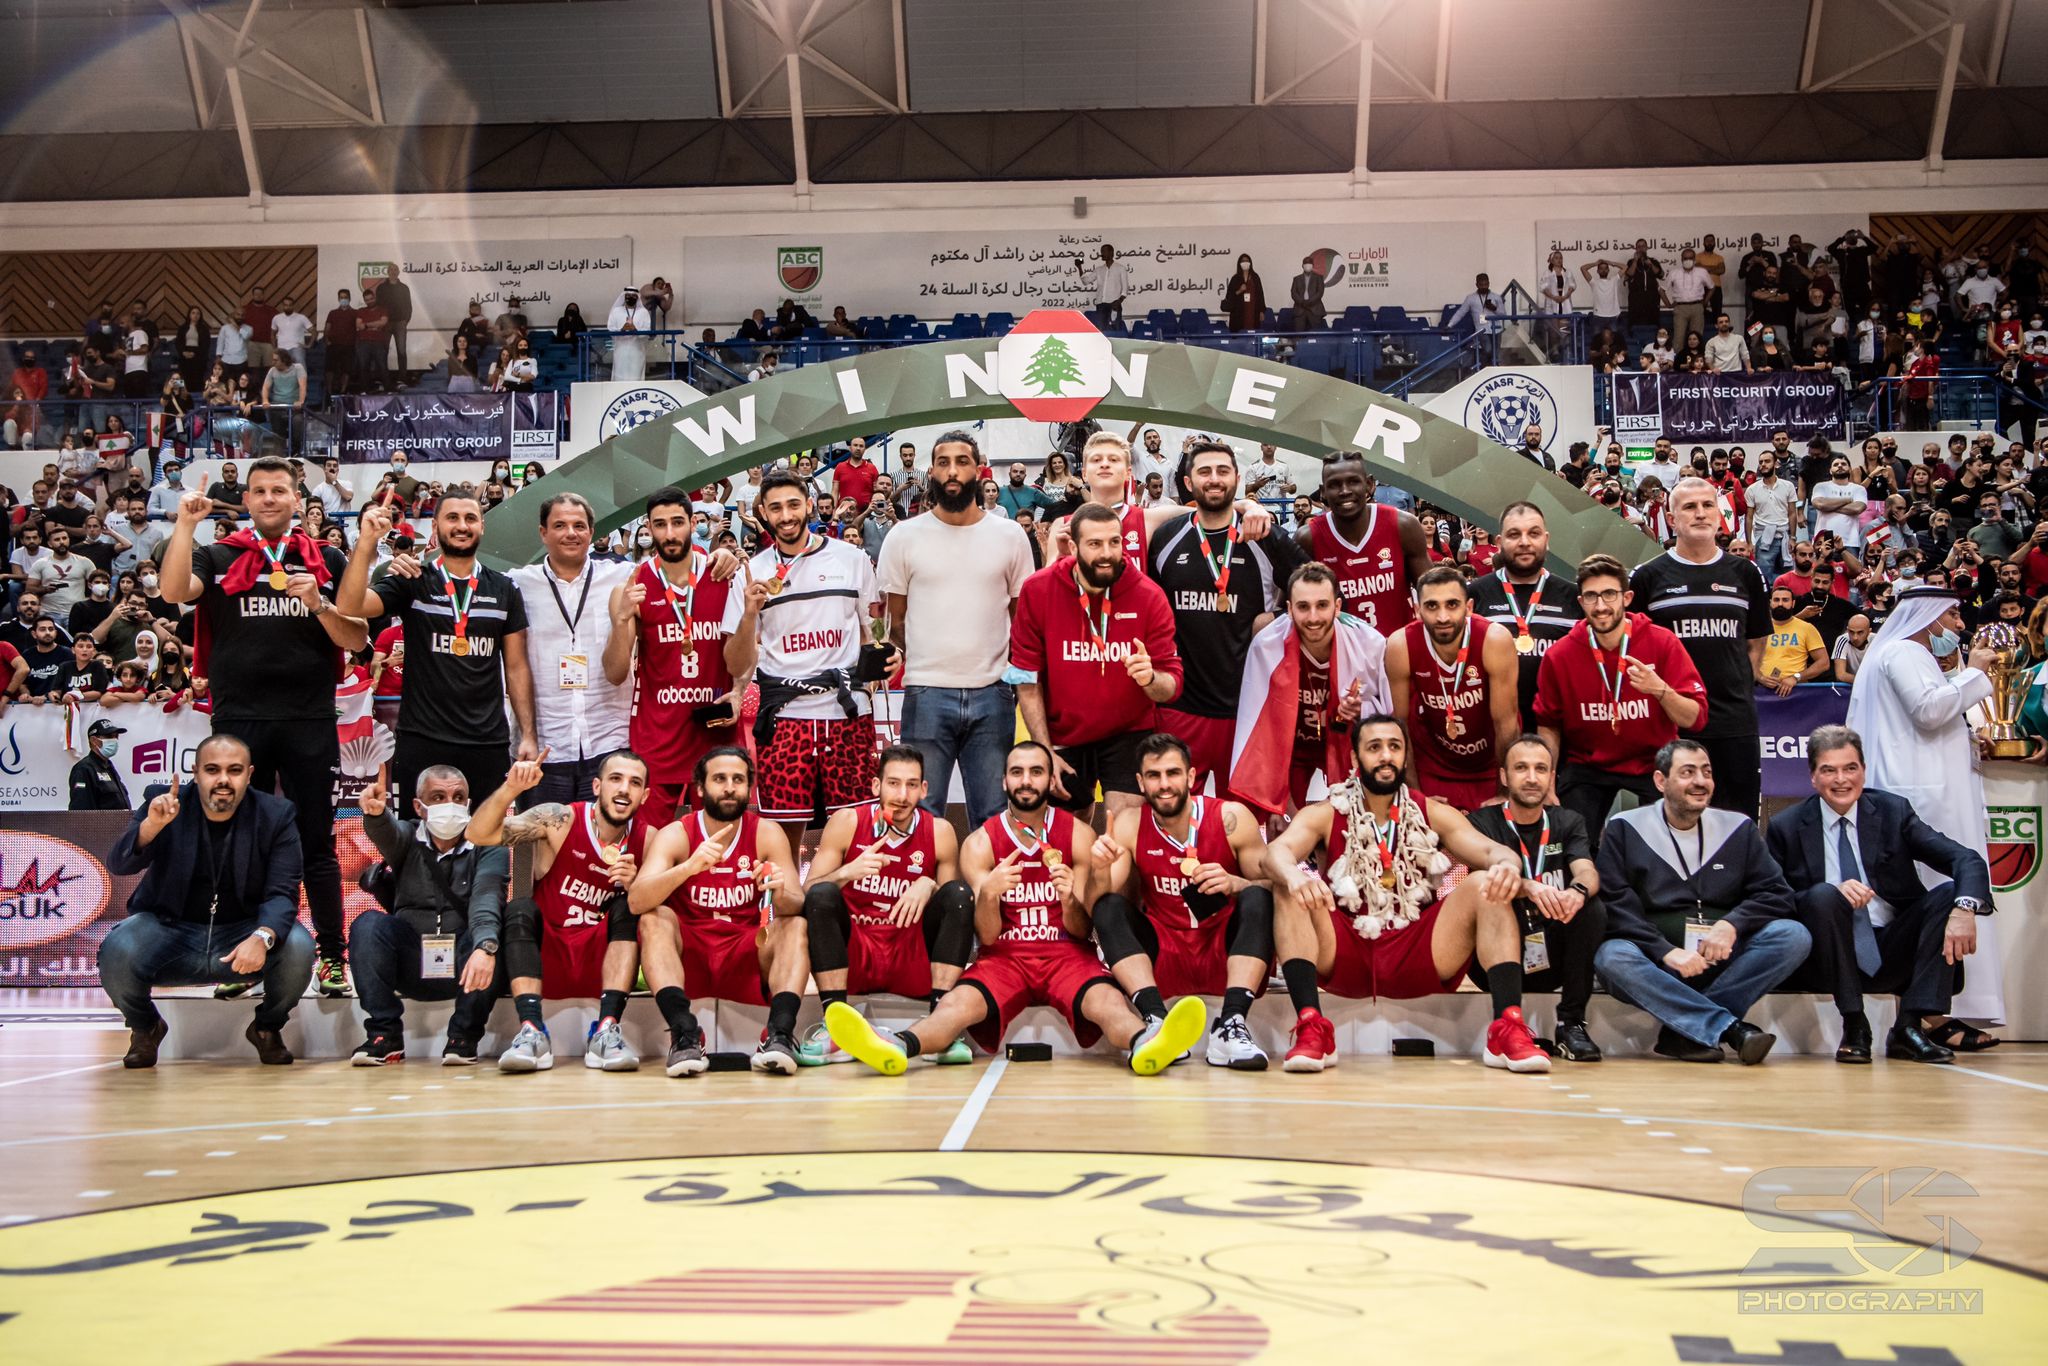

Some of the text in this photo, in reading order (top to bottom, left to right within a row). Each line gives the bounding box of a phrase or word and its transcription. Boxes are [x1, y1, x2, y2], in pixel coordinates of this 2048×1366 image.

[1059, 235, 1079, 245] رعاية
[1550, 240, 1582, 252] السلة
[1586, 240, 1609, 253] لكرة
[782, 253, 819, 264] ABC
[930, 249, 969, 266] مكتوم
[974, 245, 990, 262] آل
[993, 246, 1024, 261] راشد
[1029, 249, 1044, 261] بن
[1049, 248, 1085, 259] محمد
[1156, 243, 1197, 262] الشيخ
[1201, 246, 1231, 258] سمو
[402, 258, 620, 275] اتحاد الإمارات العربية المتحدة لكرة السلة
[1028, 264, 1062, 276] الرياضي
[1348, 262, 1389, 275] UAE
[500, 279, 520, 288] يرحب
[920, 284, 938, 296] 24
[942, 282, 978, 296] السلة
[982, 281, 1008, 297] لكرة
[1012, 281, 1043, 297] رجال
[1167, 278, 1212, 294] البطولة
[1042, 299, 1065, 308] 2022
[1473, 378, 1514, 406] AL-NASR
[1669, 385, 1835, 399] FIRST SECURITY GROUP
[460, 402, 504, 420] فيرست
[609, 392, 648, 420] AL-NASR
[672, 353, 1424, 463] WINNER
[346, 410, 389, 422] جروب
[1616, 416, 1660, 428] FIRST
[1671, 419, 1716, 432] جروب
[346, 436, 502, 450] FIRST SECURITY GROUP
[512, 432, 555, 443] FIRST
[1339, 572, 1395, 599] EBANON
[240, 596, 310, 618] LEBANON
[1174, 590, 1238, 614] LEBANN
[1358, 601, 1378, 628] 3
[1673, 618, 1738, 639] LEBANON
[782, 628, 842, 654] LEBANON
[1770, 632, 1799, 648] SPA
[681, 650, 699, 678] 8
[68, 673, 92, 688] JUST
[657, 685, 714, 704] robocom
[1985, 817, 2034, 838] BC
[691, 884, 754, 908] LEBANON
